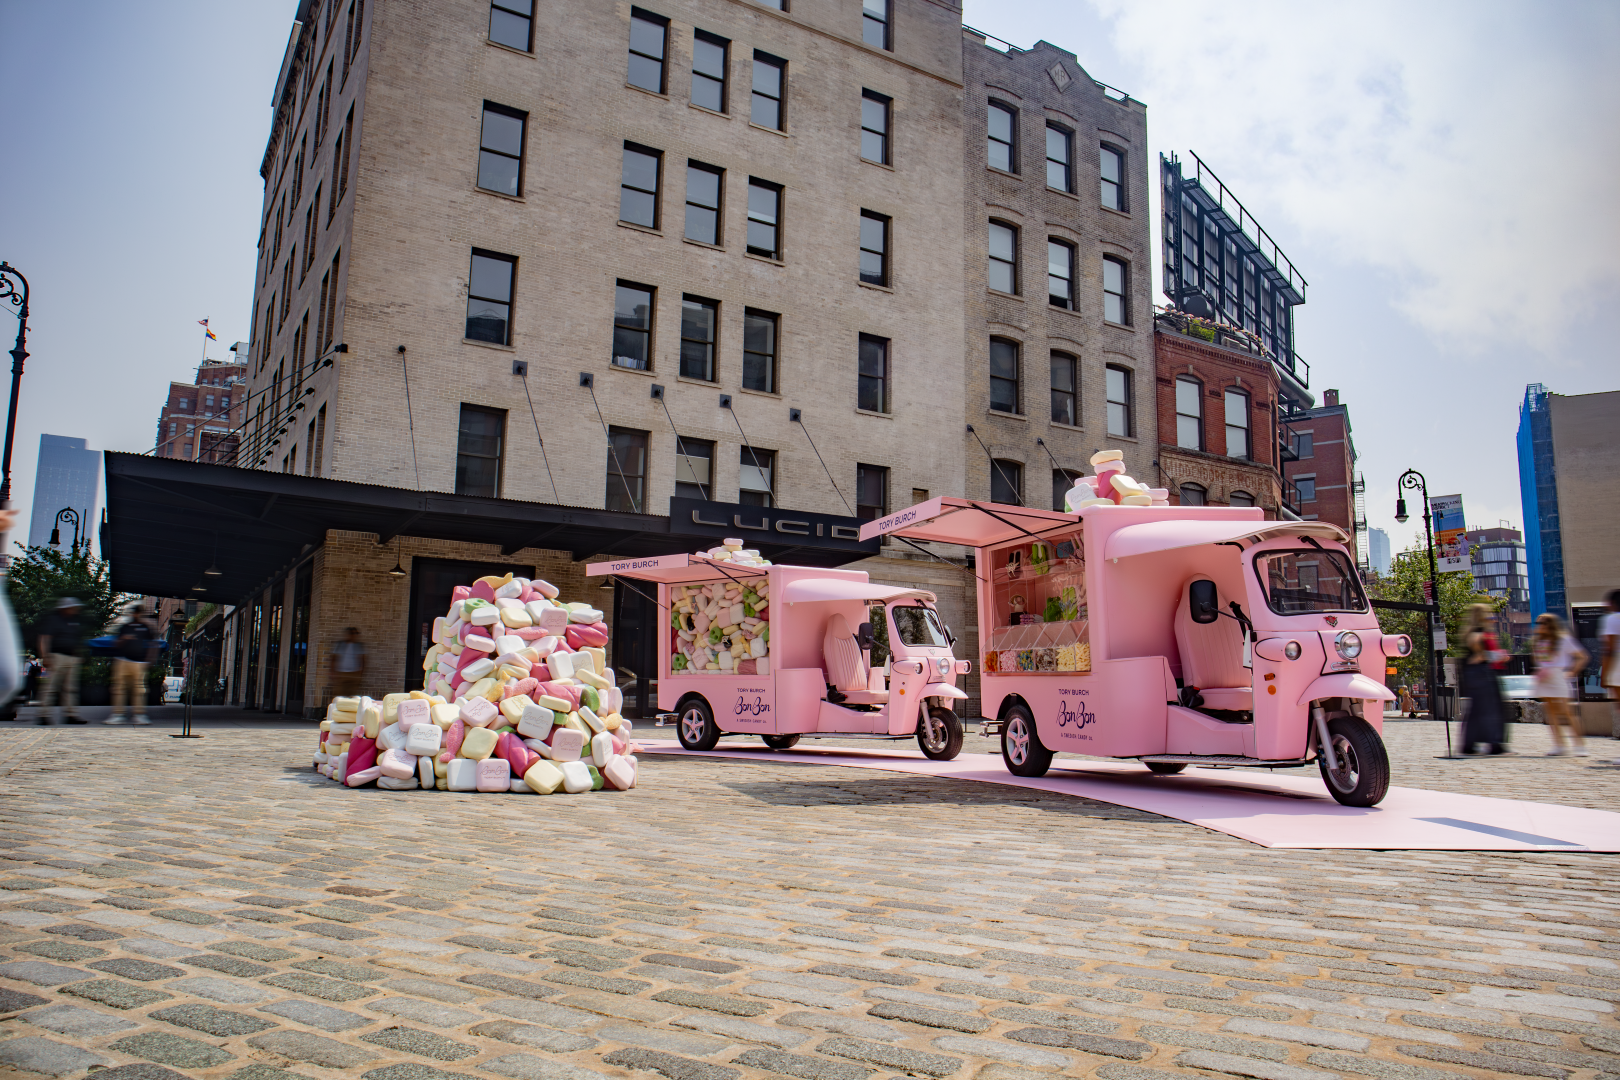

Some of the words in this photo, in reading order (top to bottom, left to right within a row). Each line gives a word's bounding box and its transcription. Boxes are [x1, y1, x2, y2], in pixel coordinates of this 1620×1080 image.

[692, 509, 860, 541] LUCID
[879, 517, 895, 531] TORY
[895, 510, 917, 525] BURCH
[611, 562, 631, 571] TORY
[632, 559, 659, 569] BURCH
